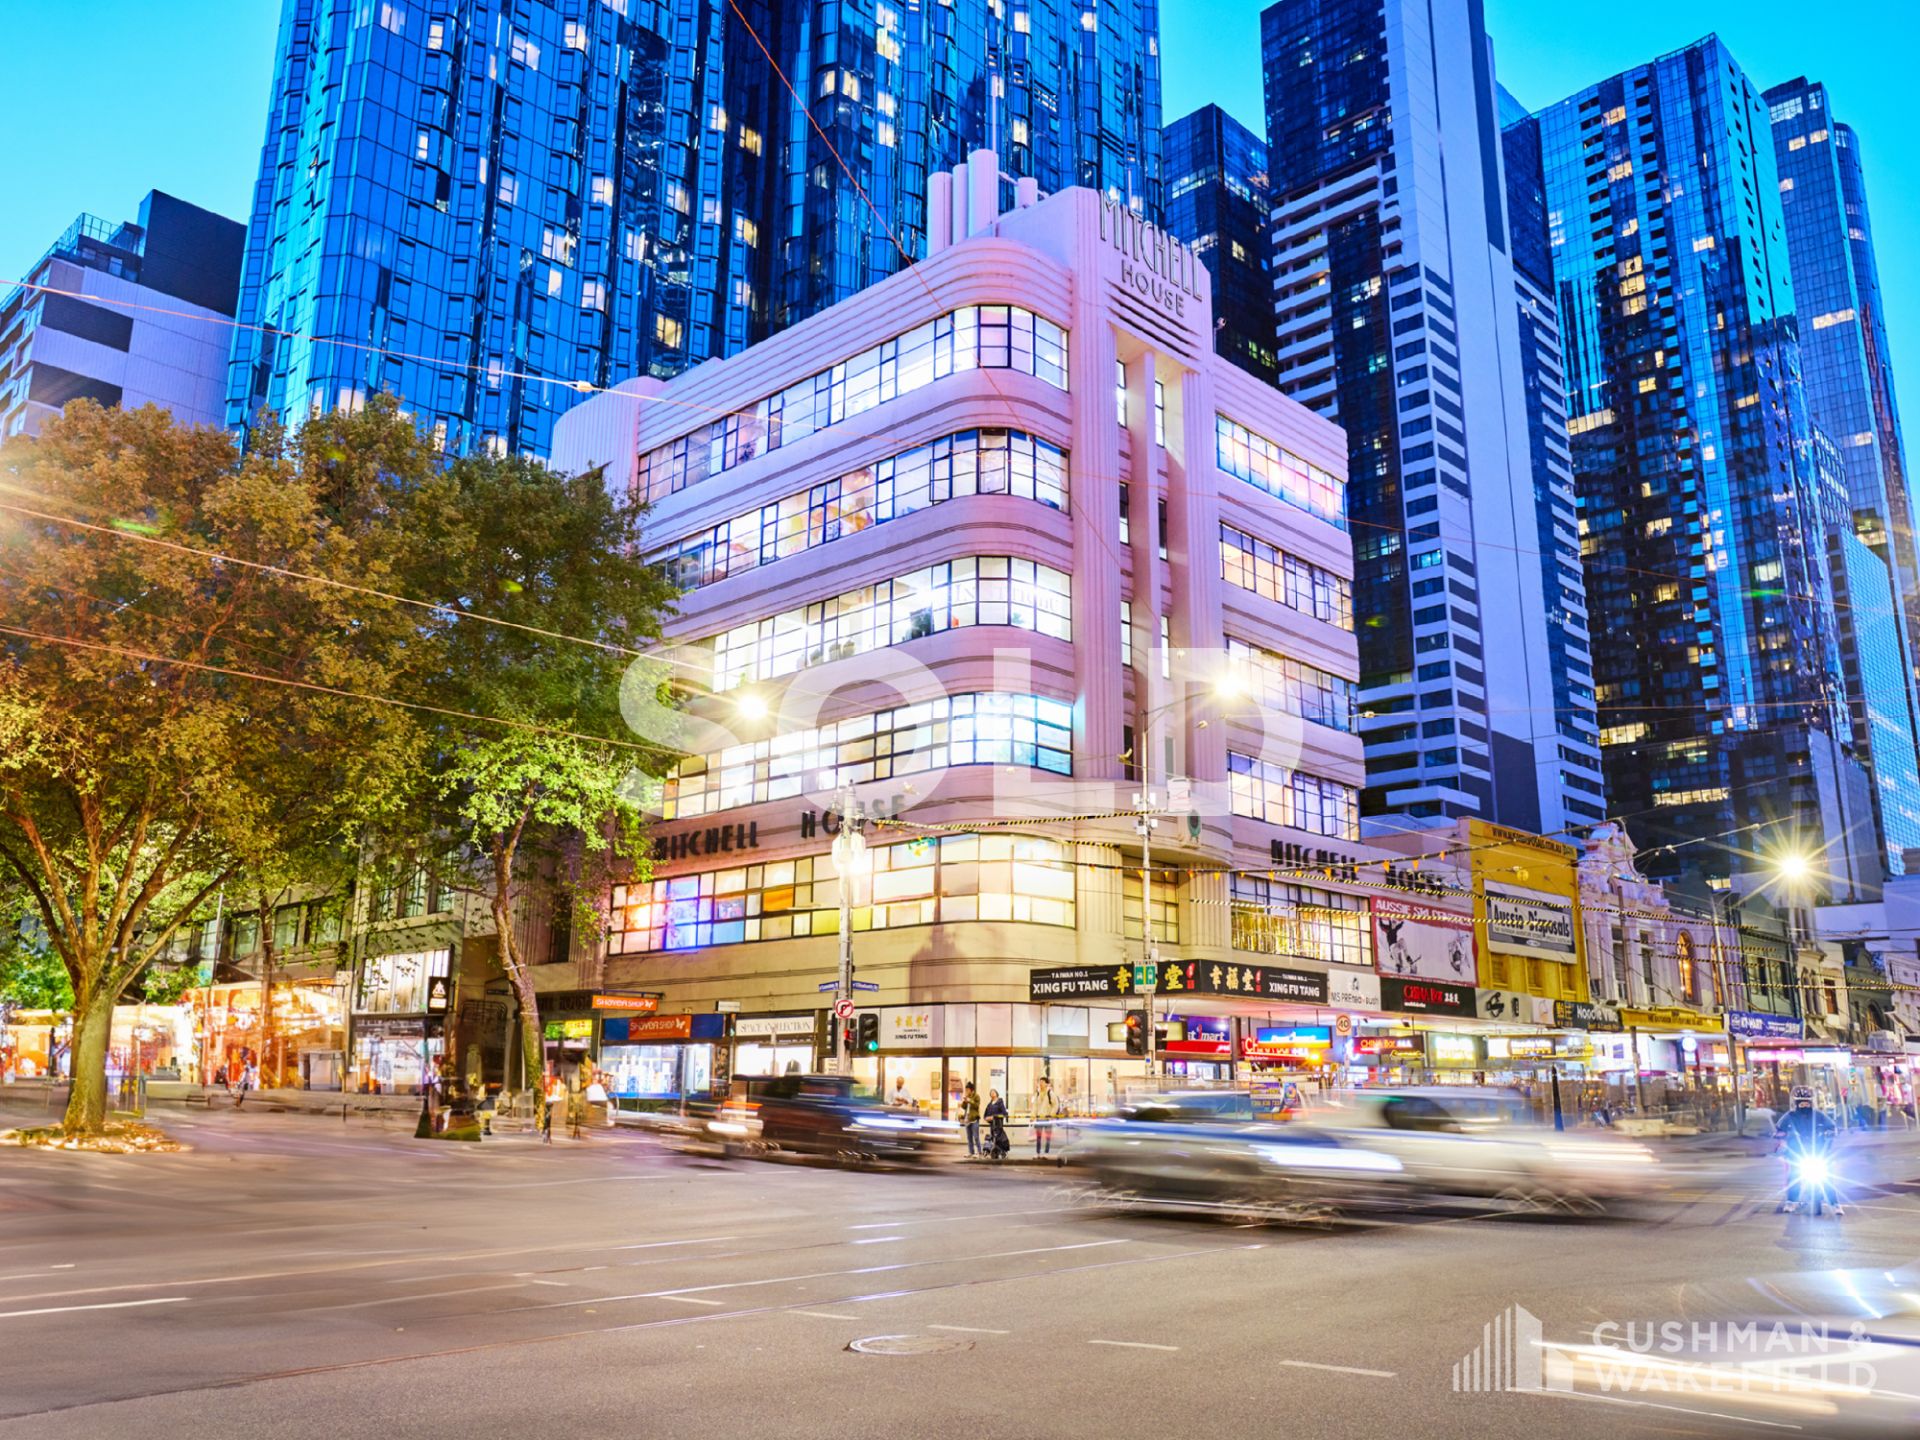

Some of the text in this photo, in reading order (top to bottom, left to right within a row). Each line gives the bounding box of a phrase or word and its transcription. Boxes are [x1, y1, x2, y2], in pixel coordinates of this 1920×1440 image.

[1100, 189, 1202, 302] MITCHELL
[1122, 260, 1184, 318] HOUSE
[654, 821, 759, 861] MITCHELL
[1271, 839, 1359, 882] MITCHELL
[1376, 899, 1410, 915] AUSSIE
[1032, 978, 1109, 995] XING FU TANG
[1051, 971, 1074, 979] TAIWAN
[1113, 963, 1184, 994] 幸堂
[1209, 964, 1255, 992] 幸福堂
[1268, 981, 1288, 994] XING
[1288, 983, 1299, 996] FU
[1299, 984, 1320, 998] TANG
[1338, 1019, 1349, 1029] 40
